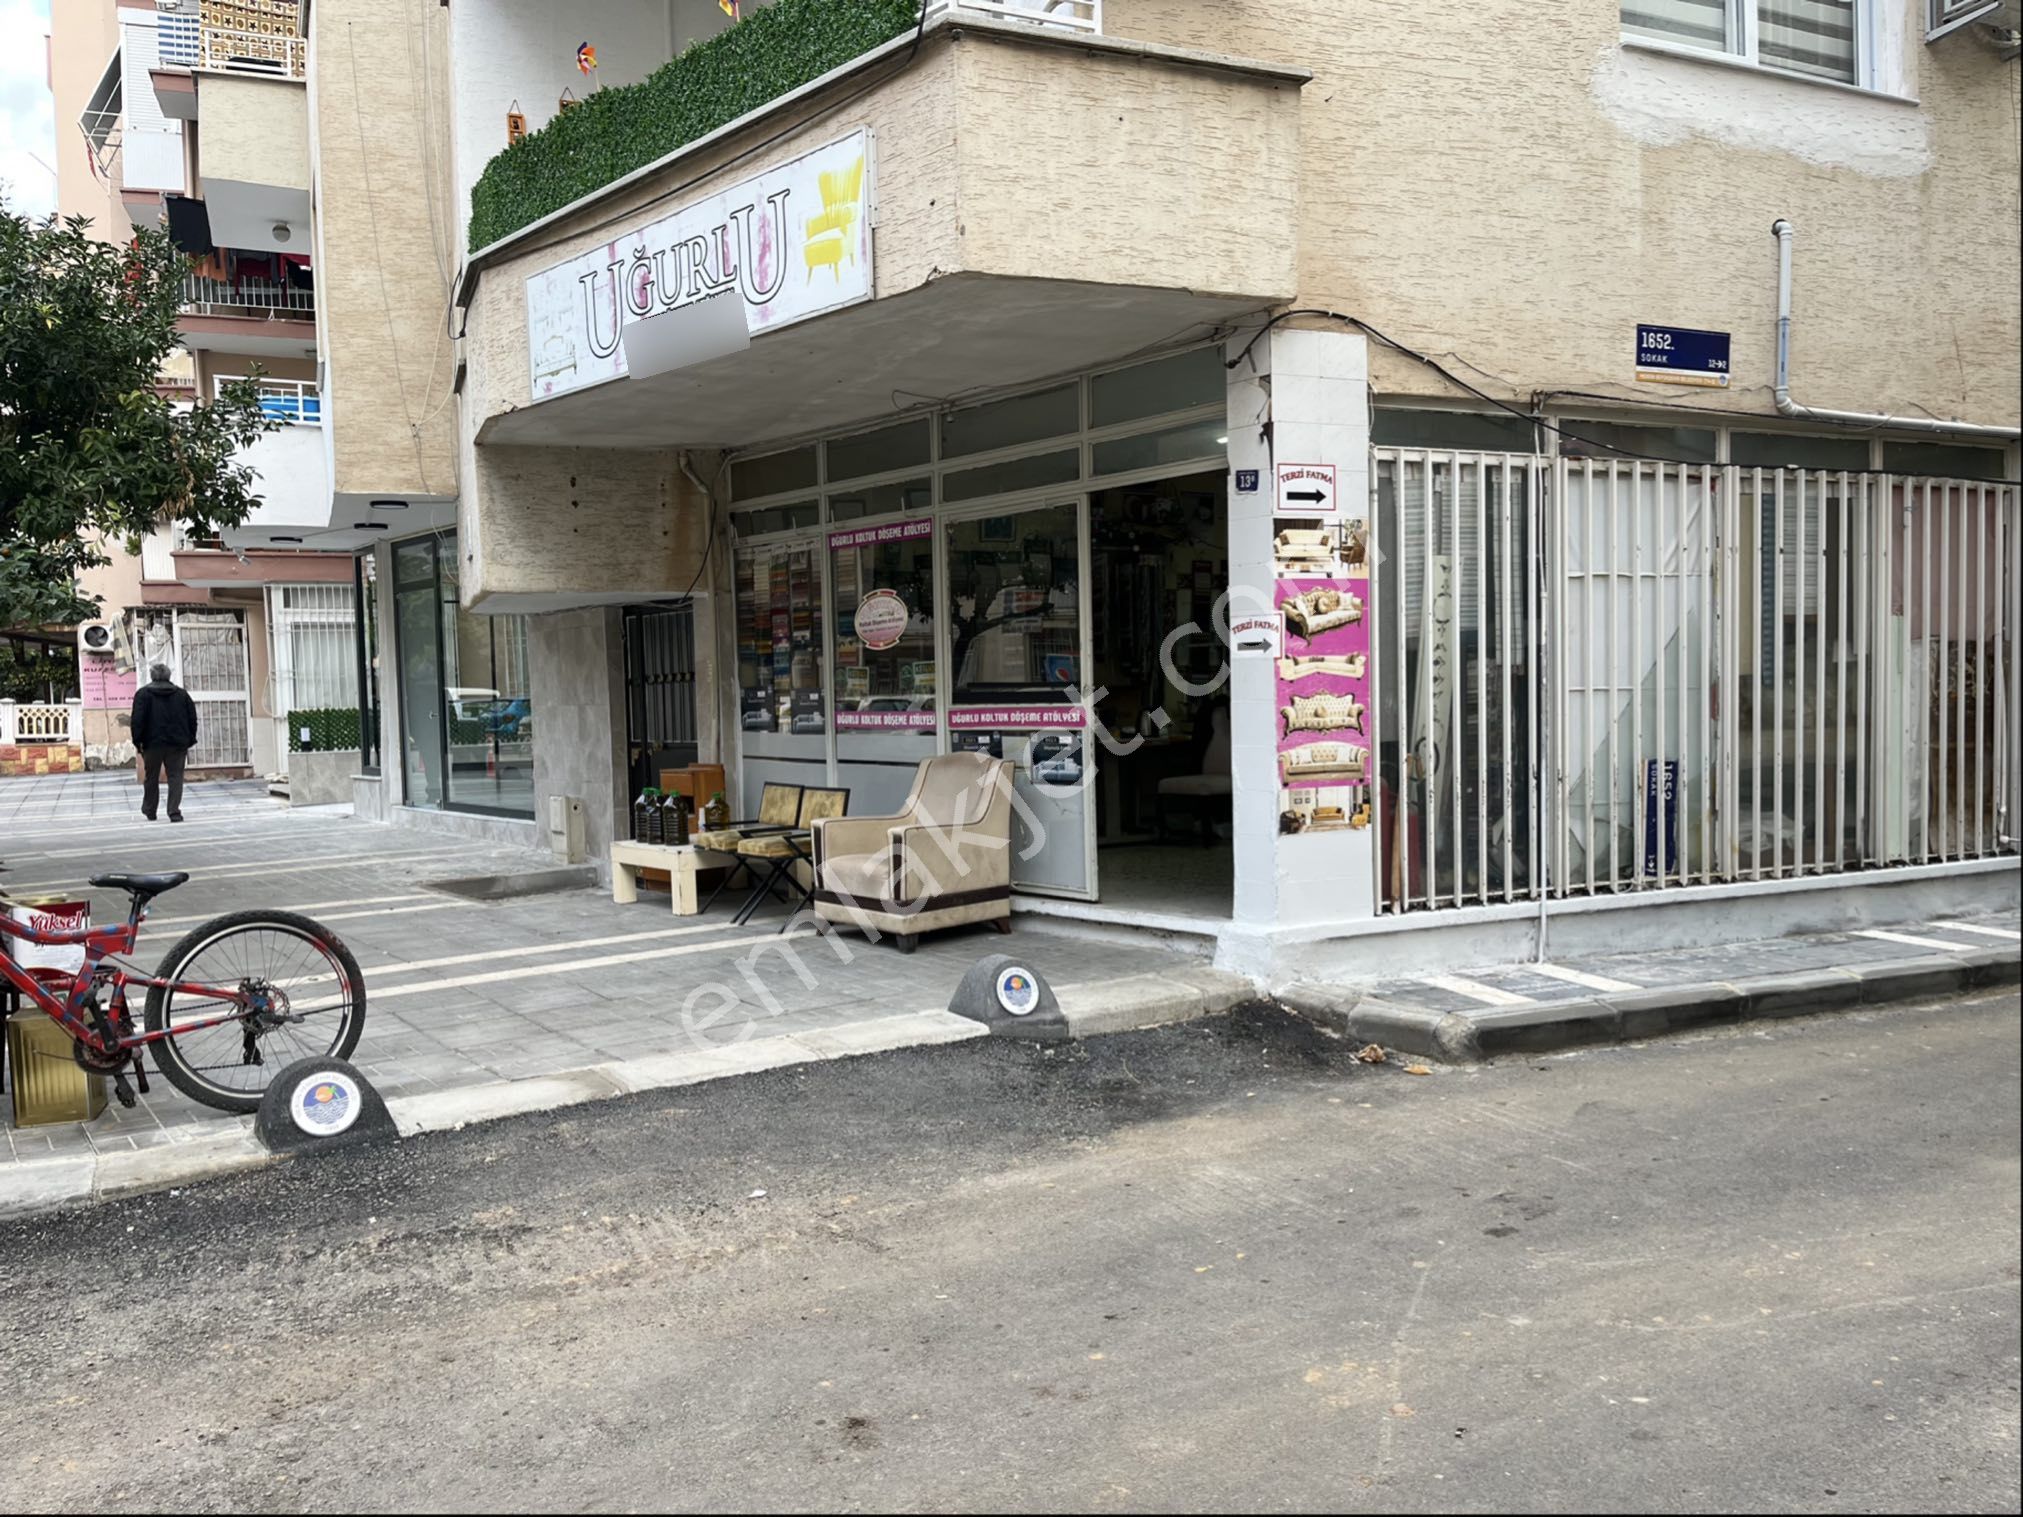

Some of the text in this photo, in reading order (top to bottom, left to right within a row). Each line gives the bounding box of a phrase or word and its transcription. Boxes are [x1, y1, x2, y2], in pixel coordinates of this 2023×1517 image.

[579, 188, 791, 359] UĞURLU
[1641, 331, 1675, 350] 1652.
[1641, 352, 1668, 363] SOKAK
[1280, 468, 1333, 485] TERZİ FATMA
[855, 530, 876, 543] KOLTUK
[1231, 618, 1279, 635] TERZİ FATMA
[861, 714, 882, 725] KOLTUK
[981, 711, 1009, 723] KOLTUK
[1010, 711, 1041, 725] DÖŞEME
[1043, 709, 1080, 722] ATÖLYESİ
[29, 908, 84, 931] Yüksel
